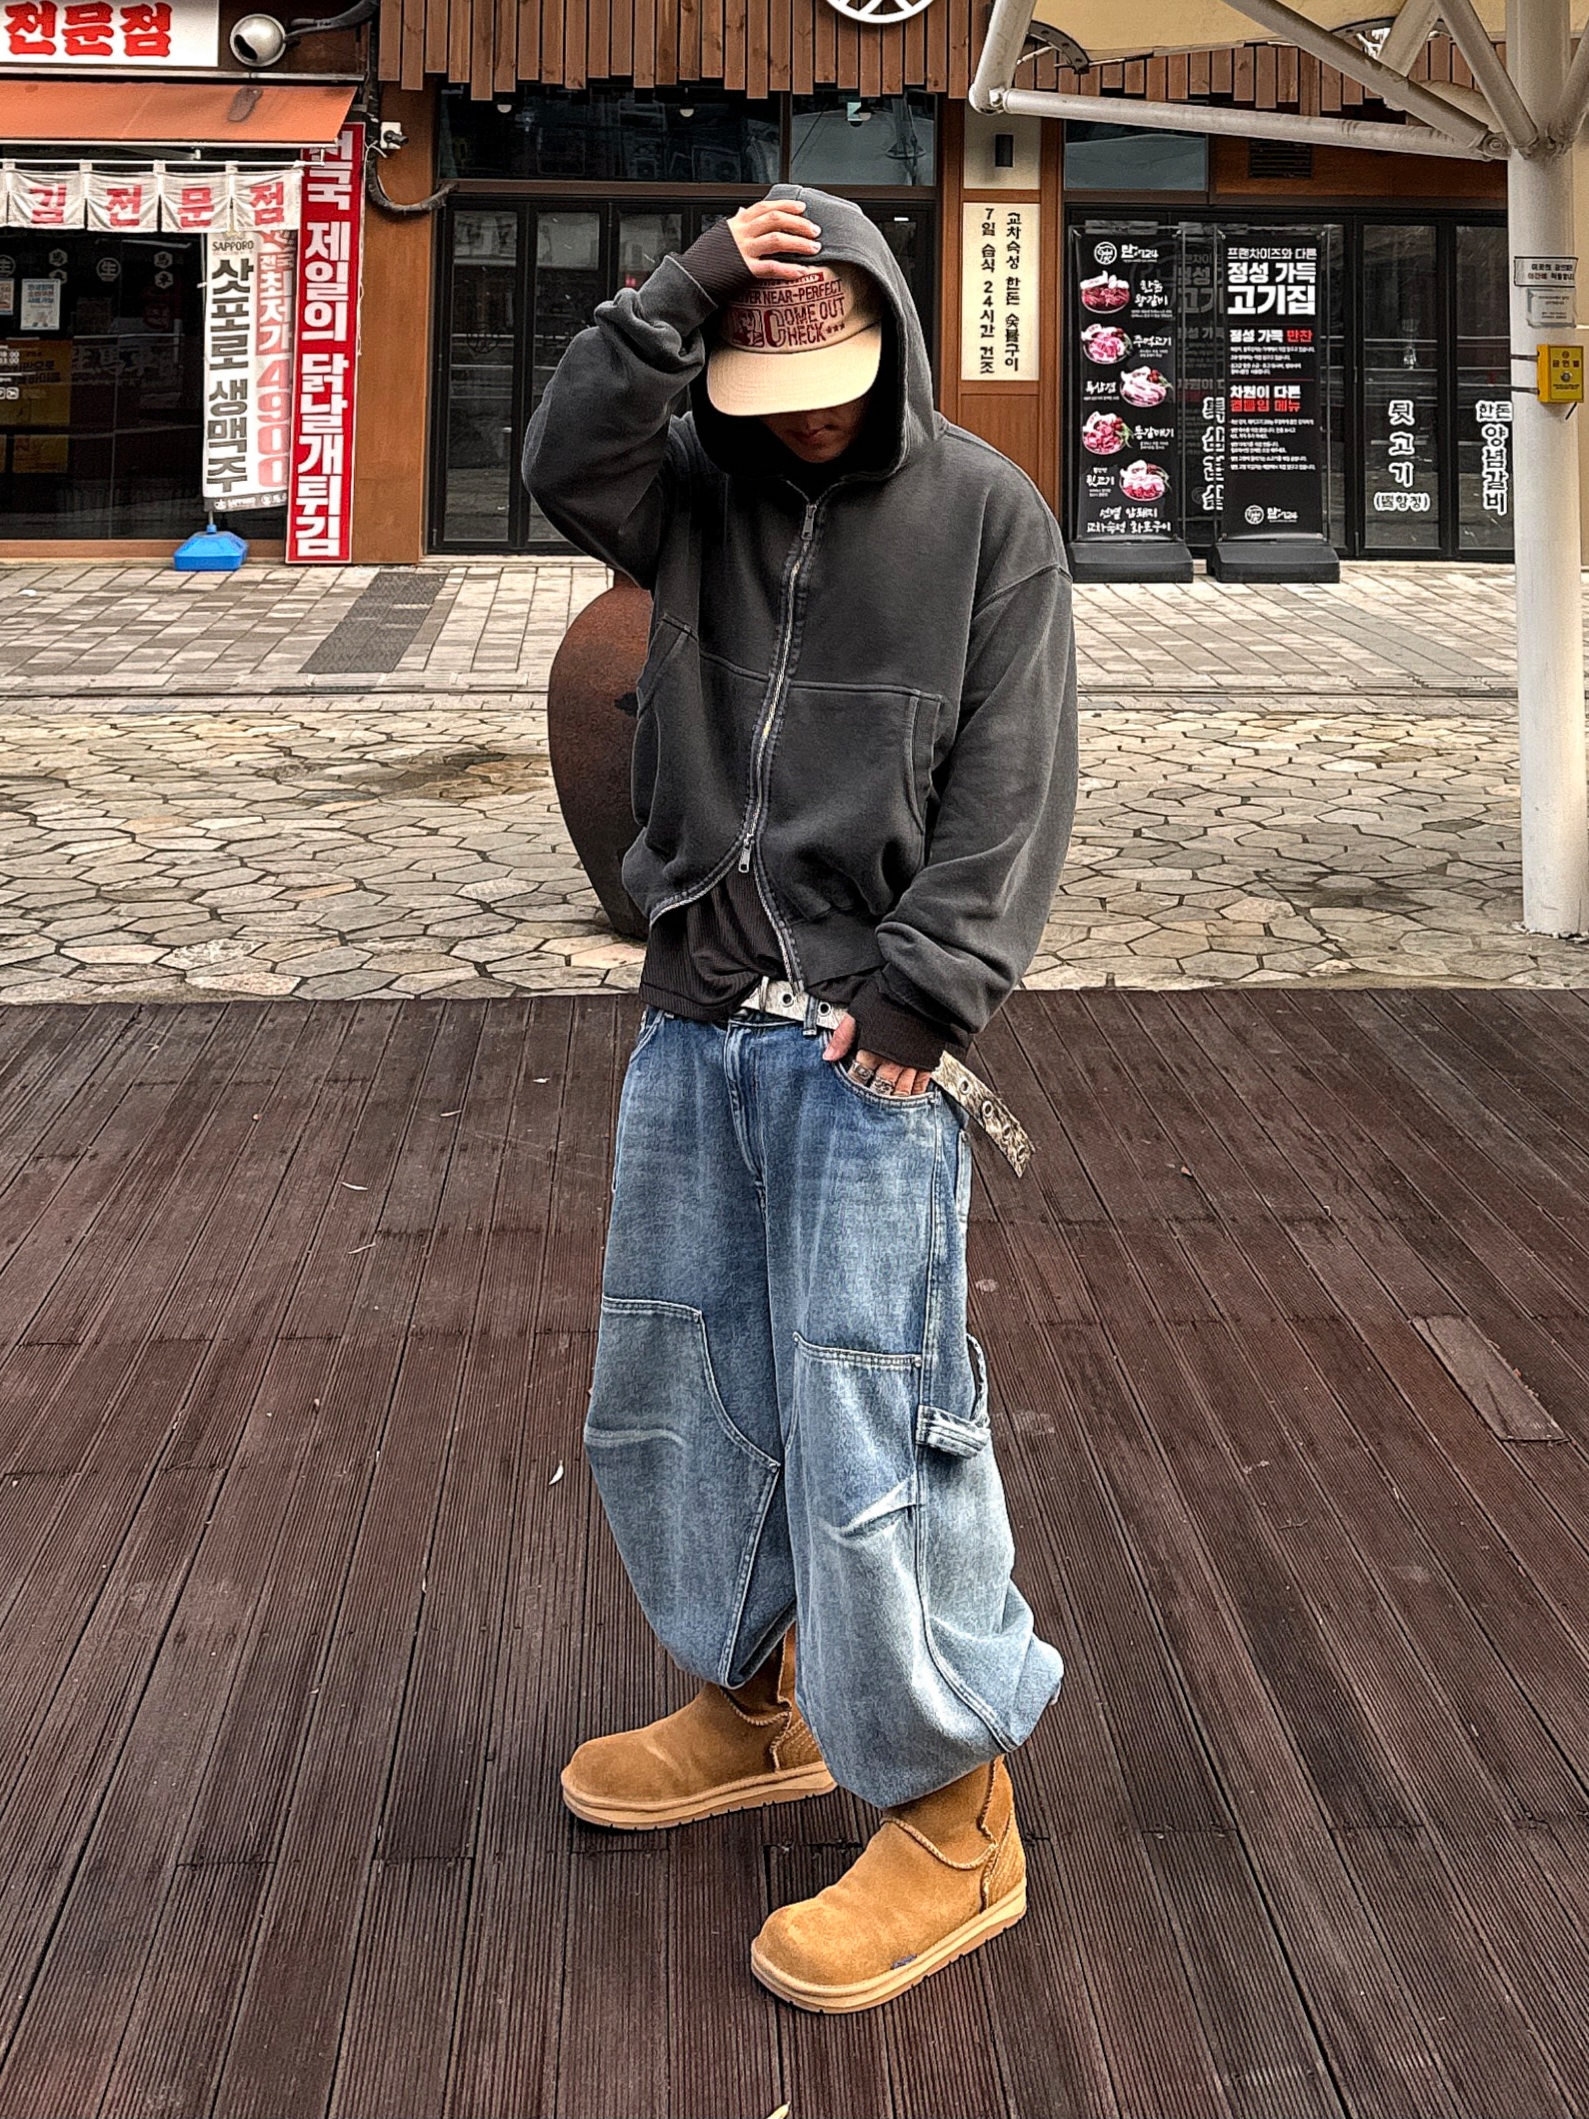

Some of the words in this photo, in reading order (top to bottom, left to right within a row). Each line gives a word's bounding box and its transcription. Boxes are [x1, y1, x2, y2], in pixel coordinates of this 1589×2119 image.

[4, 1, 172, 57] 전문점
[981, 208, 996, 237] 7일
[212, 240, 254, 252] SAPPORO
[1006, 212, 1022, 270] 교차숙성
[1227, 247, 1293, 260] 프랜차이즈와
[1295, 247, 1318, 260] 다른
[980, 243, 996, 273] 습식
[1227, 262, 1269, 284] 정성
[1275, 262, 1317, 284] 가득
[301, 221, 350, 341] 제일의
[764, 279, 843, 305] NEAR-PERFECT
[1005, 276, 1021, 306] 한돈
[209, 258, 254, 371] 삿포로
[818, 296, 846, 320] OUT
[980, 280, 995, 339] 24시간
[1227, 284, 1316, 315] 고기집
[1004, 313, 1020, 372] 숯불구이
[1229, 329, 1255, 343] 정성
[1257, 329, 1283, 343] 가득
[979, 346, 995, 375] 건조
[1230, 385, 1270, 399] 차원이
[1274, 385, 1301, 399] 다른
[1274, 399, 1301, 413] 메뉴
[256, 358, 290, 488] 4900
[1476, 400, 1513, 422] 한돈
[206, 378, 248, 493] 생맥주
[1388, 400, 1415, 488] 뒷고기
[295, 353, 350, 557] 닭날개튀김
[1481, 423, 1509, 516] 양념갈비
[1129, 521, 1171, 534] 화로구이
